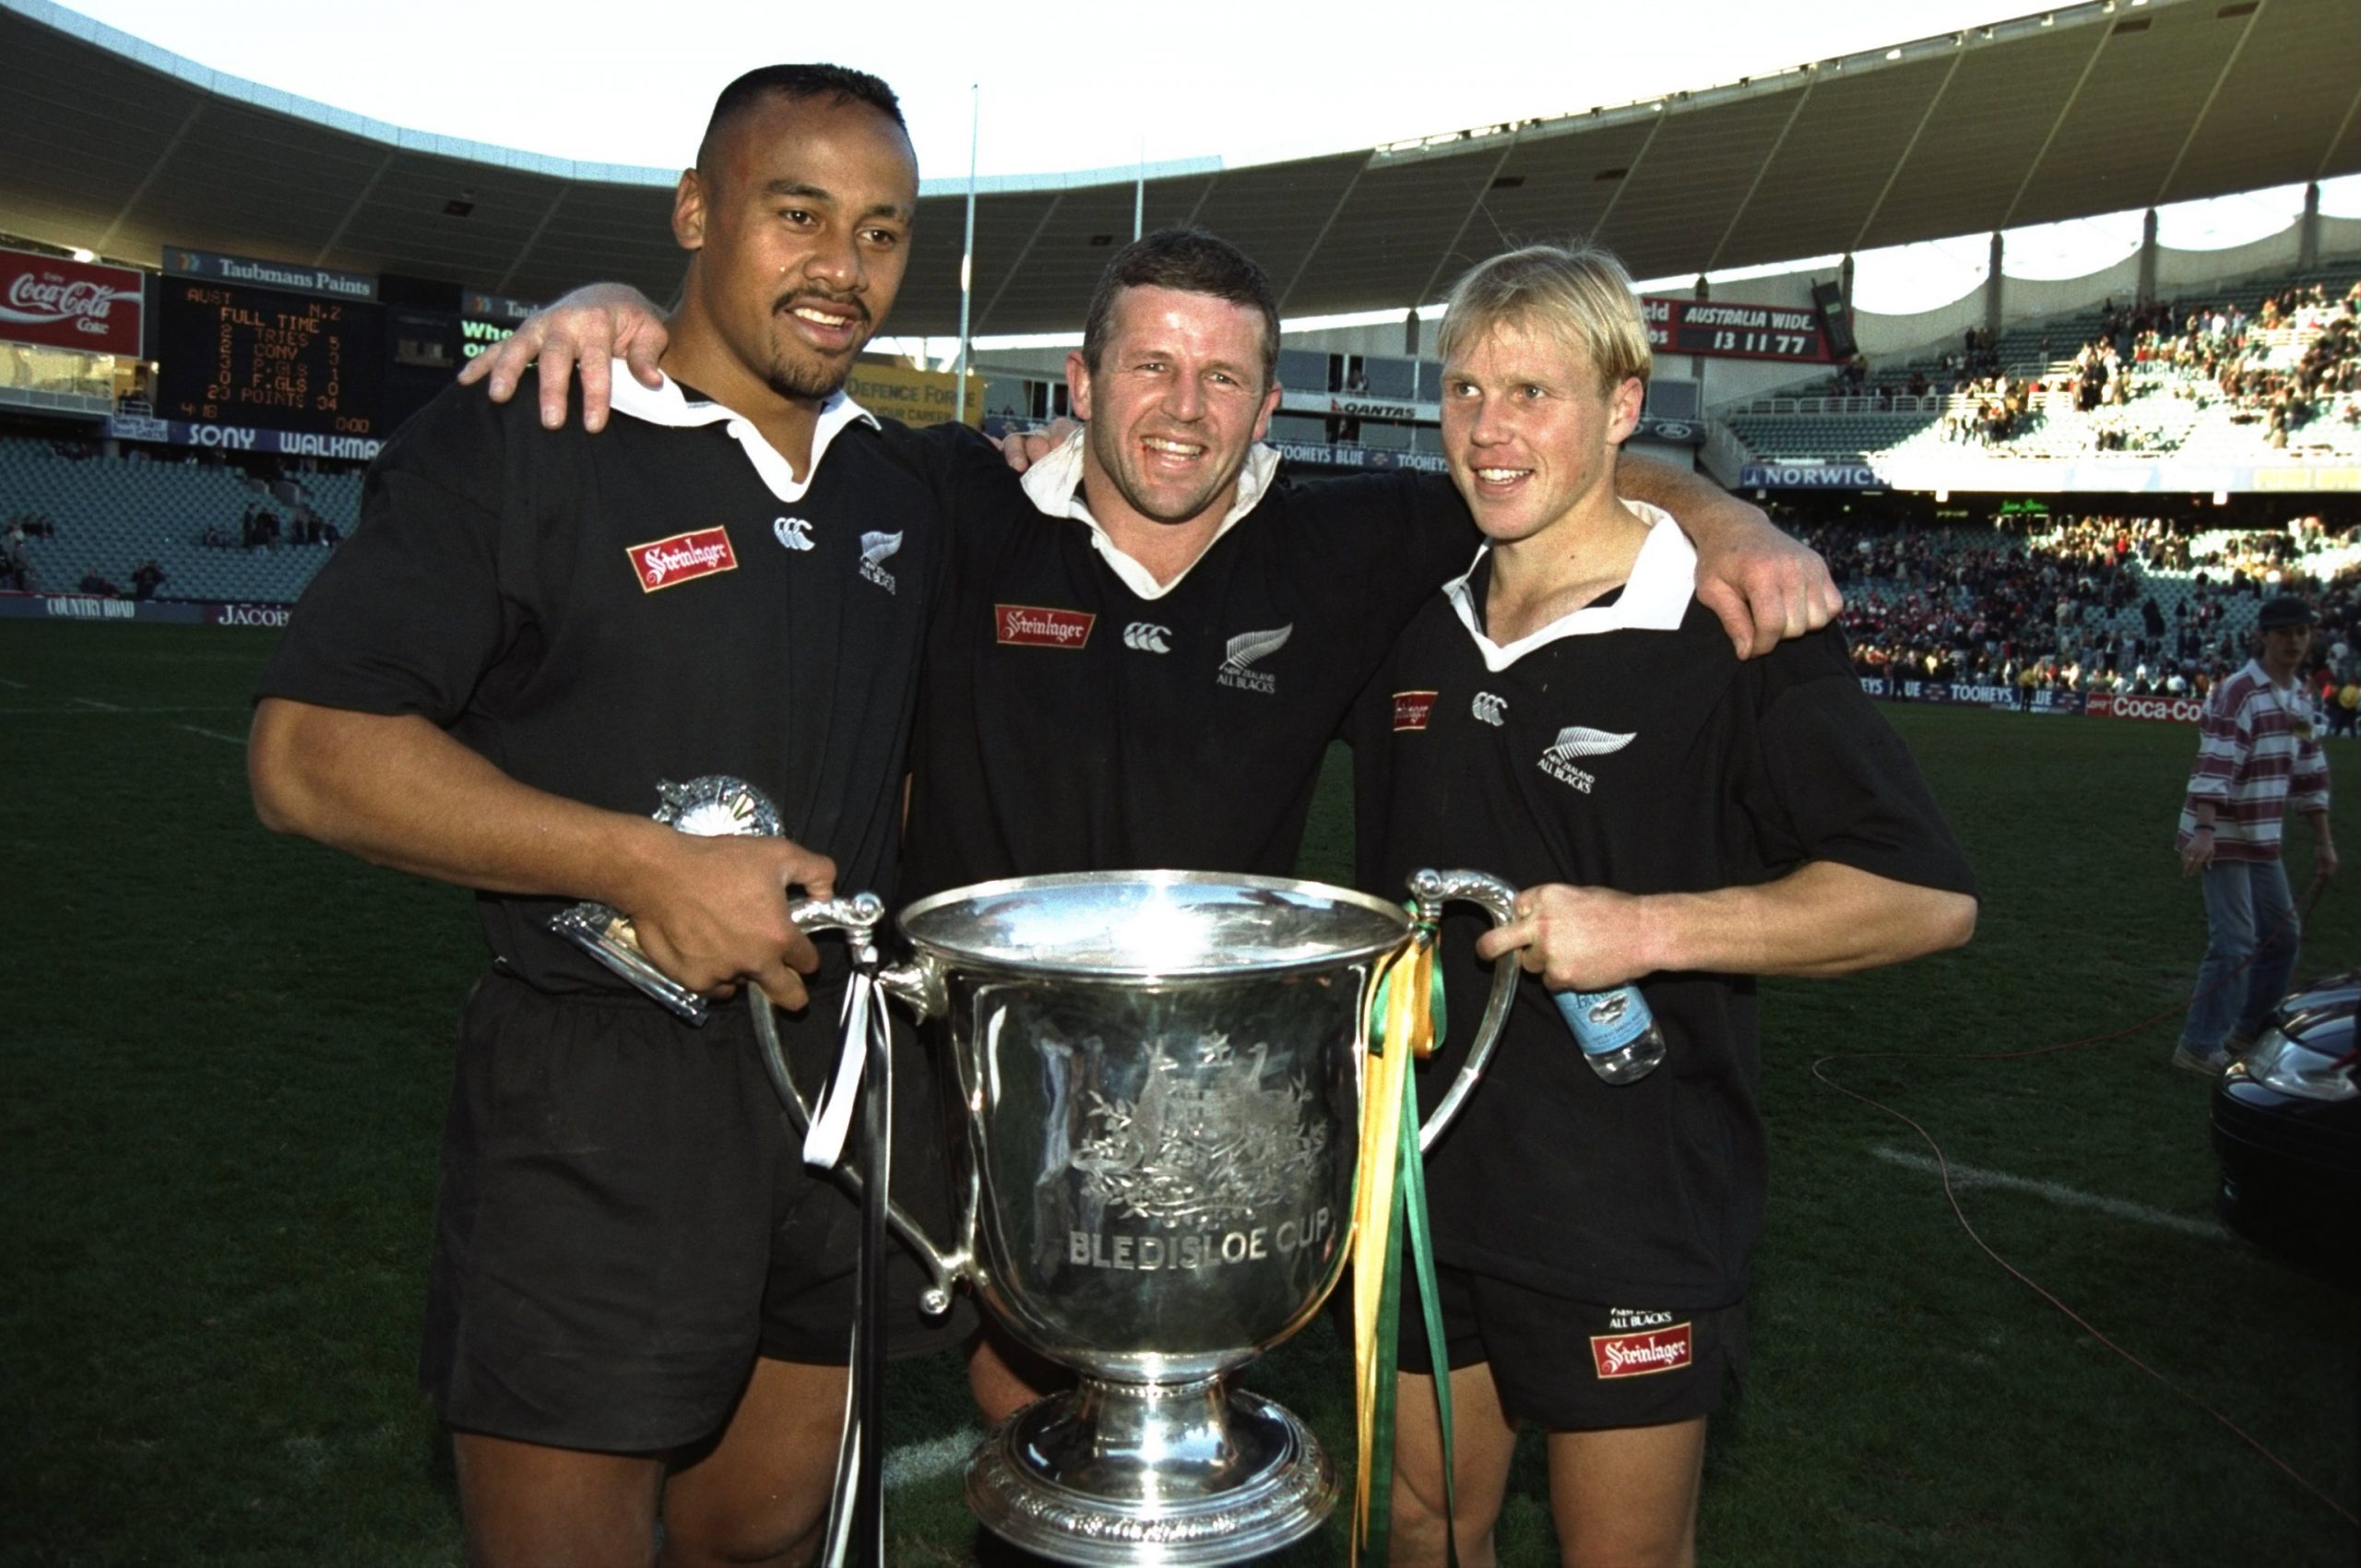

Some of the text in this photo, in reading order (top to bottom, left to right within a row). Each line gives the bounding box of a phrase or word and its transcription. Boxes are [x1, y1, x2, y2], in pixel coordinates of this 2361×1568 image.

[219, 258, 371, 296] Taubmans Paints
[9, 273, 114, 318] Coca-Cola
[220, 307, 319, 333] FULL TIME
[1685, 307, 1766, 327] AUSTRALIA
[255, 327, 309, 347] TRIES
[329, 336, 339, 350] 5
[1714, 331, 1806, 353] 13 11 77
[254, 344, 298, 360] CONV
[252, 374, 308, 393] F.GLS
[207, 385, 338, 412] 23 POINTS 34
[924, 384, 975, 407] FORE
[1344, 402, 1418, 419] QANTAS
[188, 423, 255, 449] SONY
[279, 431, 386, 461] WALKMA
[1275, 445, 1364, 466] TOOHEYS BLUE
[646, 538, 727, 585] Steinlager
[47, 597, 135, 618] COUNTRY ROAD
[219, 604, 292, 627] JACOB
[1002, 610, 1085, 643] Steinlager
[1216, 673, 1275, 694] ALL BLACKS
[1950, 683, 2012, 703] TOOHEYS
[1536, 757, 1592, 794] ALL BLACKS
[1069, 1206, 1330, 1270] BLEDISLOE CUP
[1609, 1312, 1673, 1328] ALL BLACKS
[1602, 1336, 1686, 1373] Steinlager
